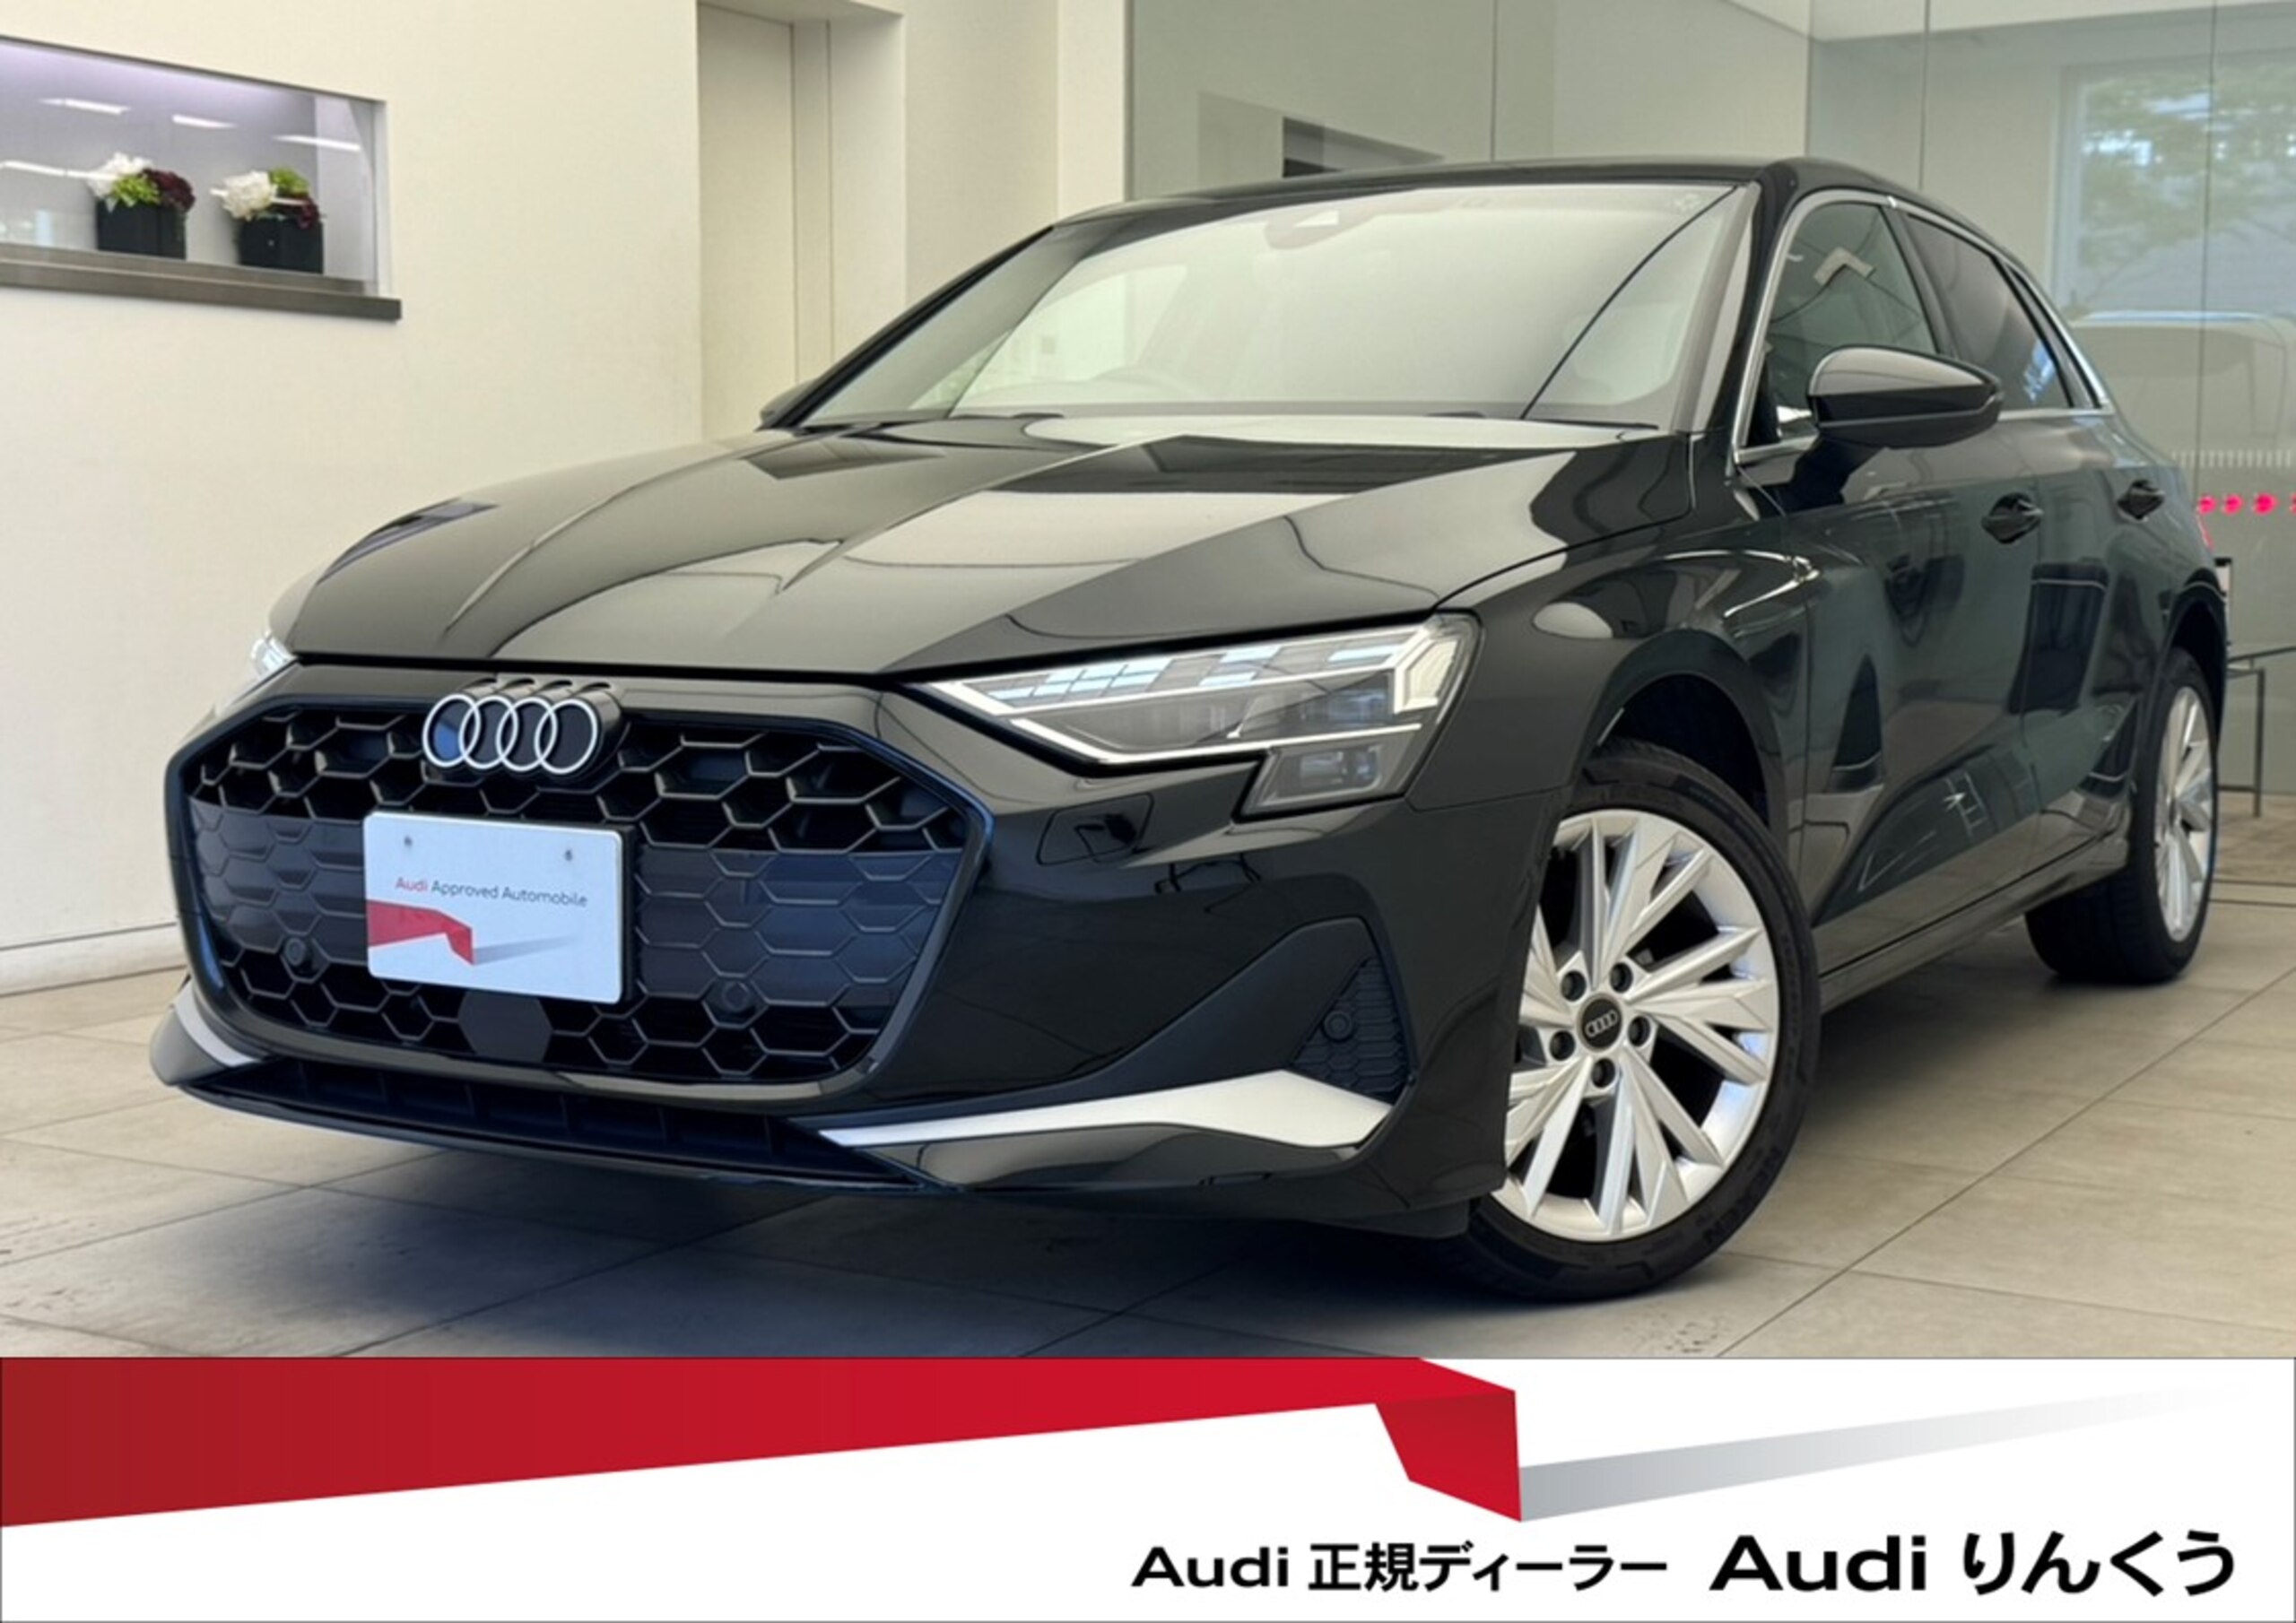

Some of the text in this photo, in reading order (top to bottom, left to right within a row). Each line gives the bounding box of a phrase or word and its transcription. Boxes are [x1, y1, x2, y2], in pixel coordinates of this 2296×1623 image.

[396, 877, 588, 907] Audi Approved Automobile
